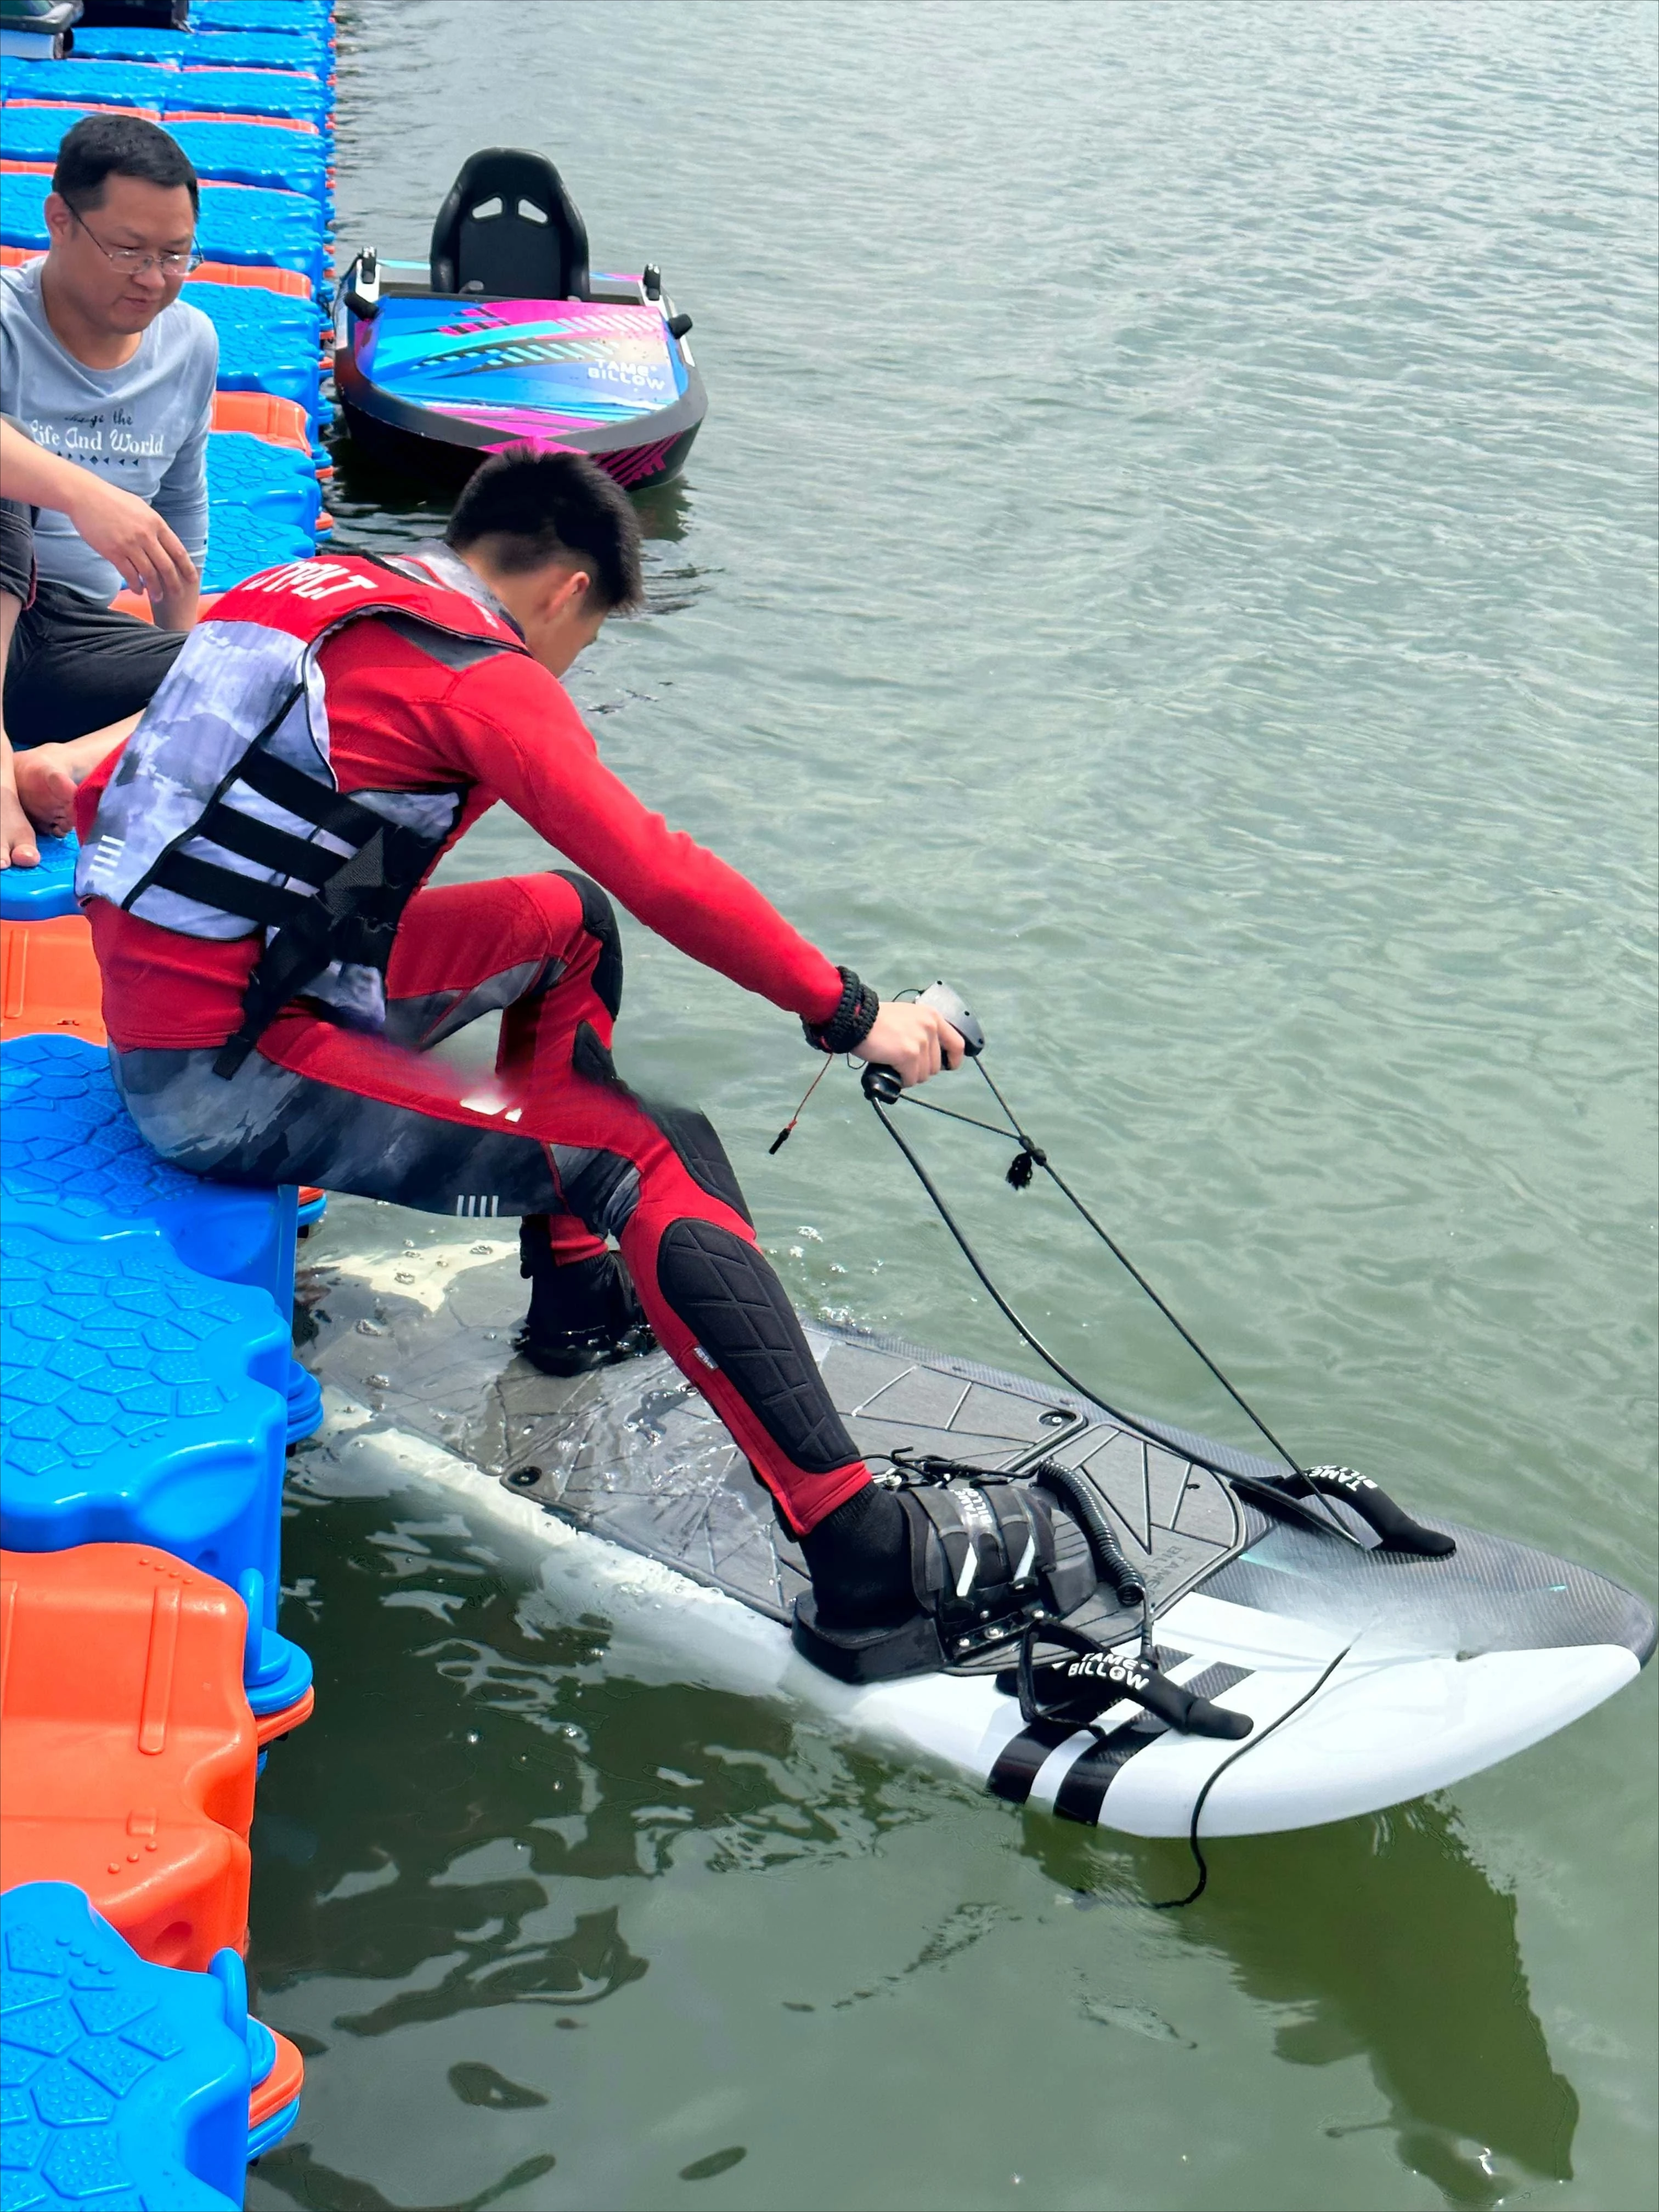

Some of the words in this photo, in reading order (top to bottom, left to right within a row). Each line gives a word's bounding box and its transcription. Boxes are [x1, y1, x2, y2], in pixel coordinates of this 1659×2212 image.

[588, 367, 665, 391] BILLOW
[113, 408, 133, 425] the
[30, 419, 60, 446] Life
[65, 427, 102, 450] And
[109, 429, 163, 456] World
[1081, 1652, 1138, 1671] TAME
[1068, 1661, 1149, 1690] BILLOW
